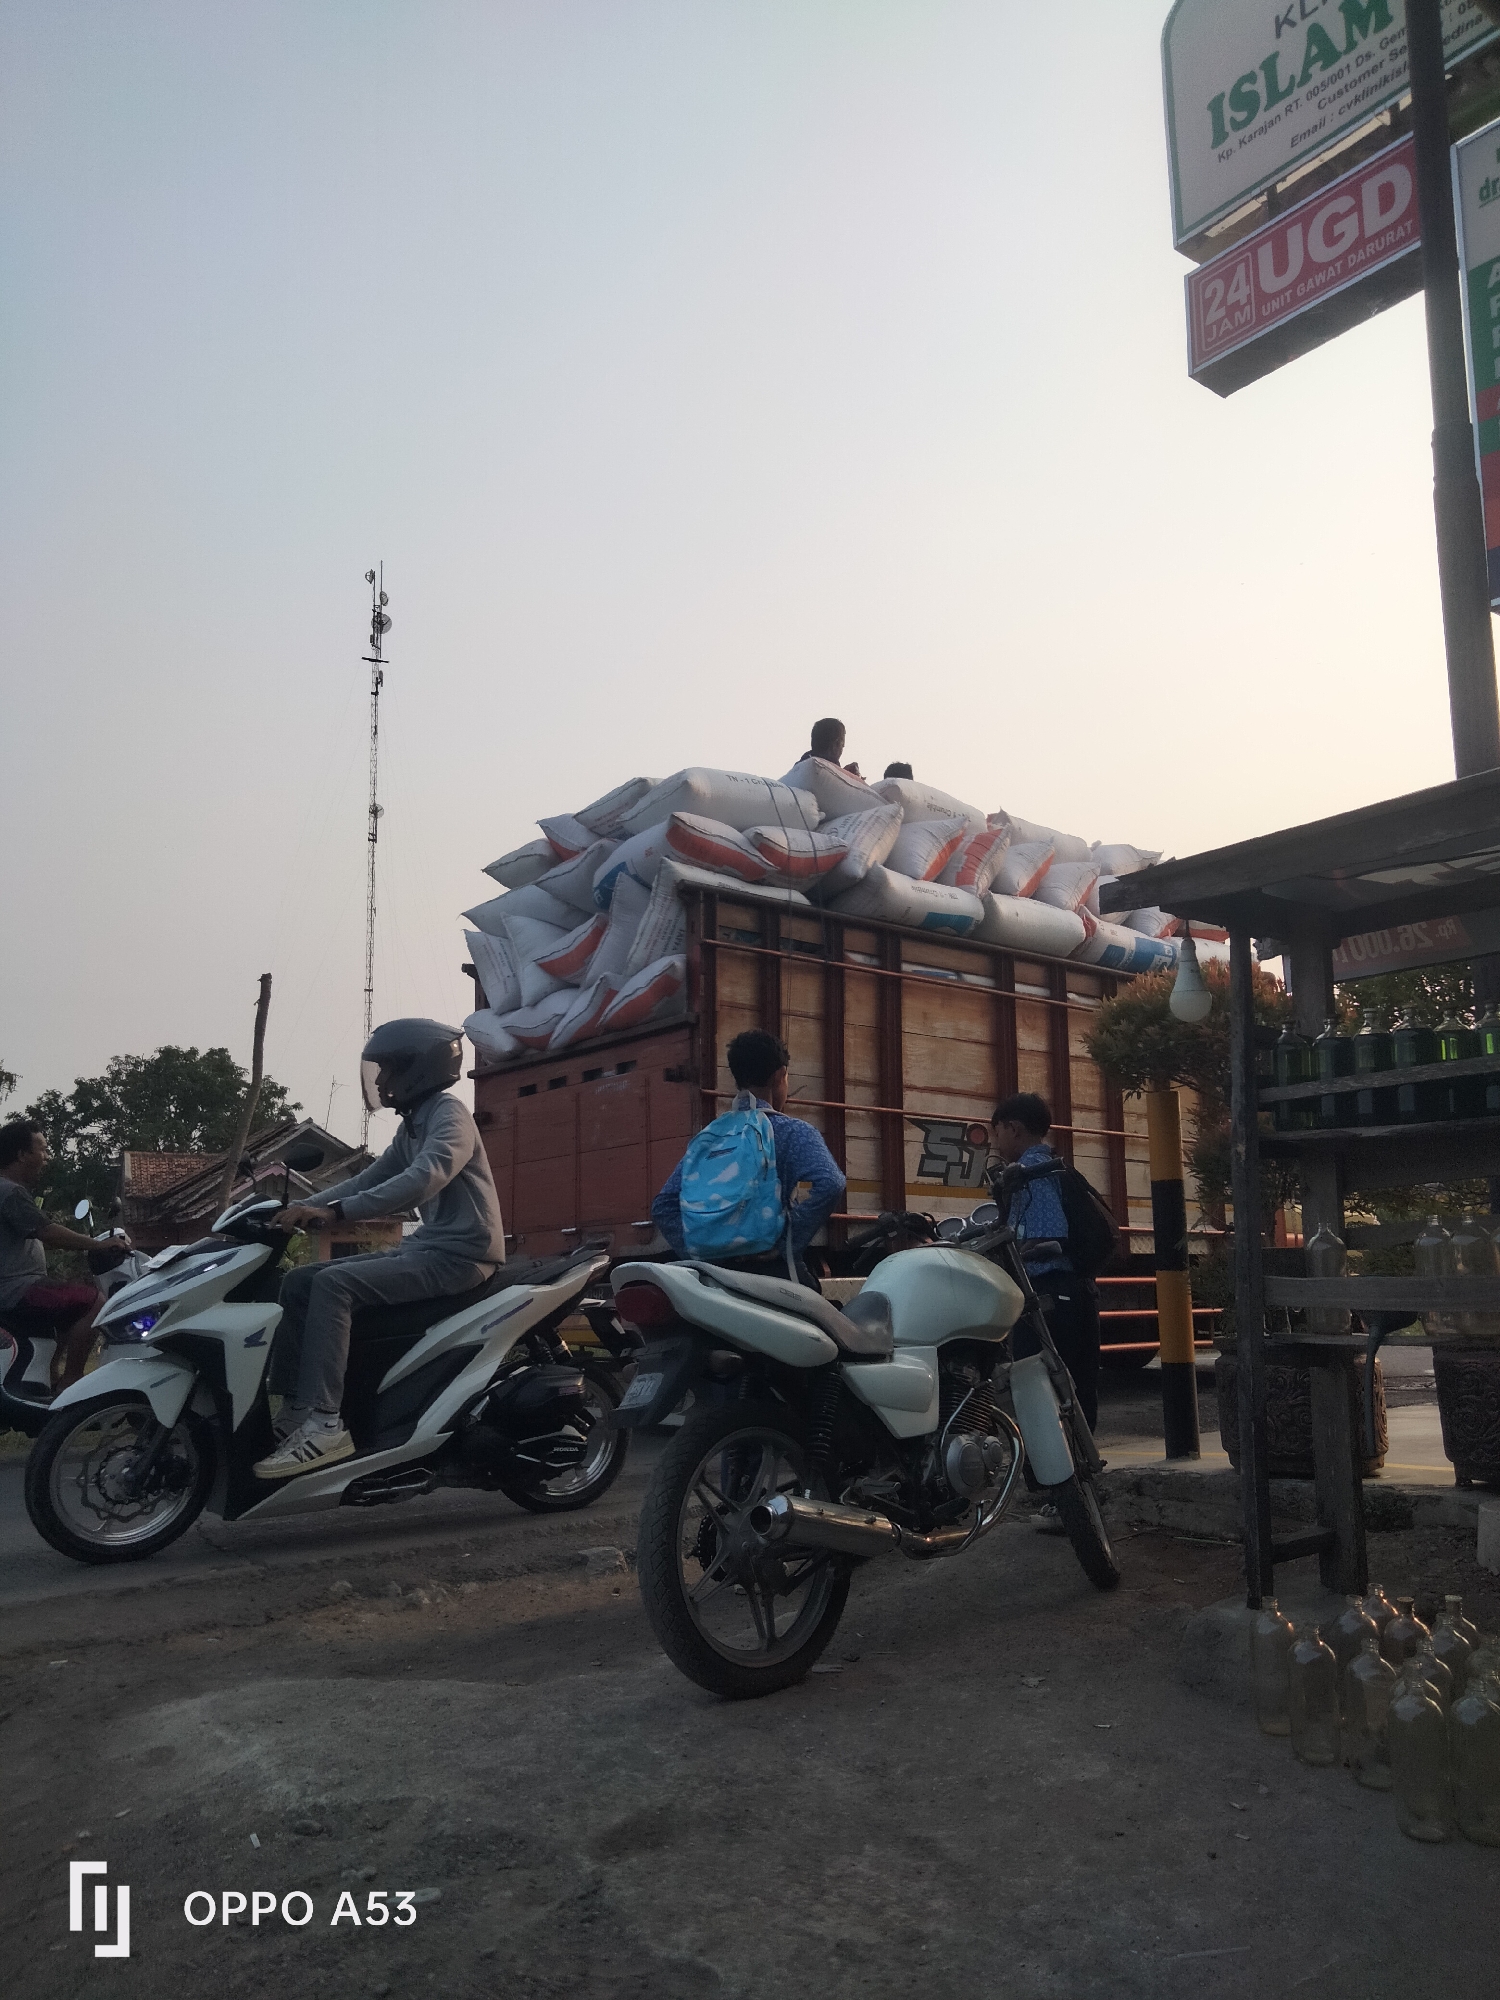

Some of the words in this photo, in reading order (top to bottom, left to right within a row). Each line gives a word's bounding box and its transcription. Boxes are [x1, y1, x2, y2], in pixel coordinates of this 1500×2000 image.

[1275, 0, 1328, 39] KL
[1207, 0, 1394, 150] ISLAM
[1217, 147, 1237, 163] Kp.
[1239, 114, 1282, 149] Karajan
[1285, 100, 1303, 117] RT.
[1306, 65, 1351, 103] 005/001
[1355, 50, 1376, 69] Ds.
[1317, 60, 1386, 110] Customer
[1388, 44, 1410, 63] Se
[1290, 113, 1327, 149] Email
[1257, 163, 1413, 294] UGD
[1204, 262, 1251, 326] 24
[1261, 291, 1293, 317] UNIT
[1297, 261, 1343, 298] GAWAT
[1347, 219, 1414, 270] DARURAT
[1206, 304, 1250, 343] JAM
